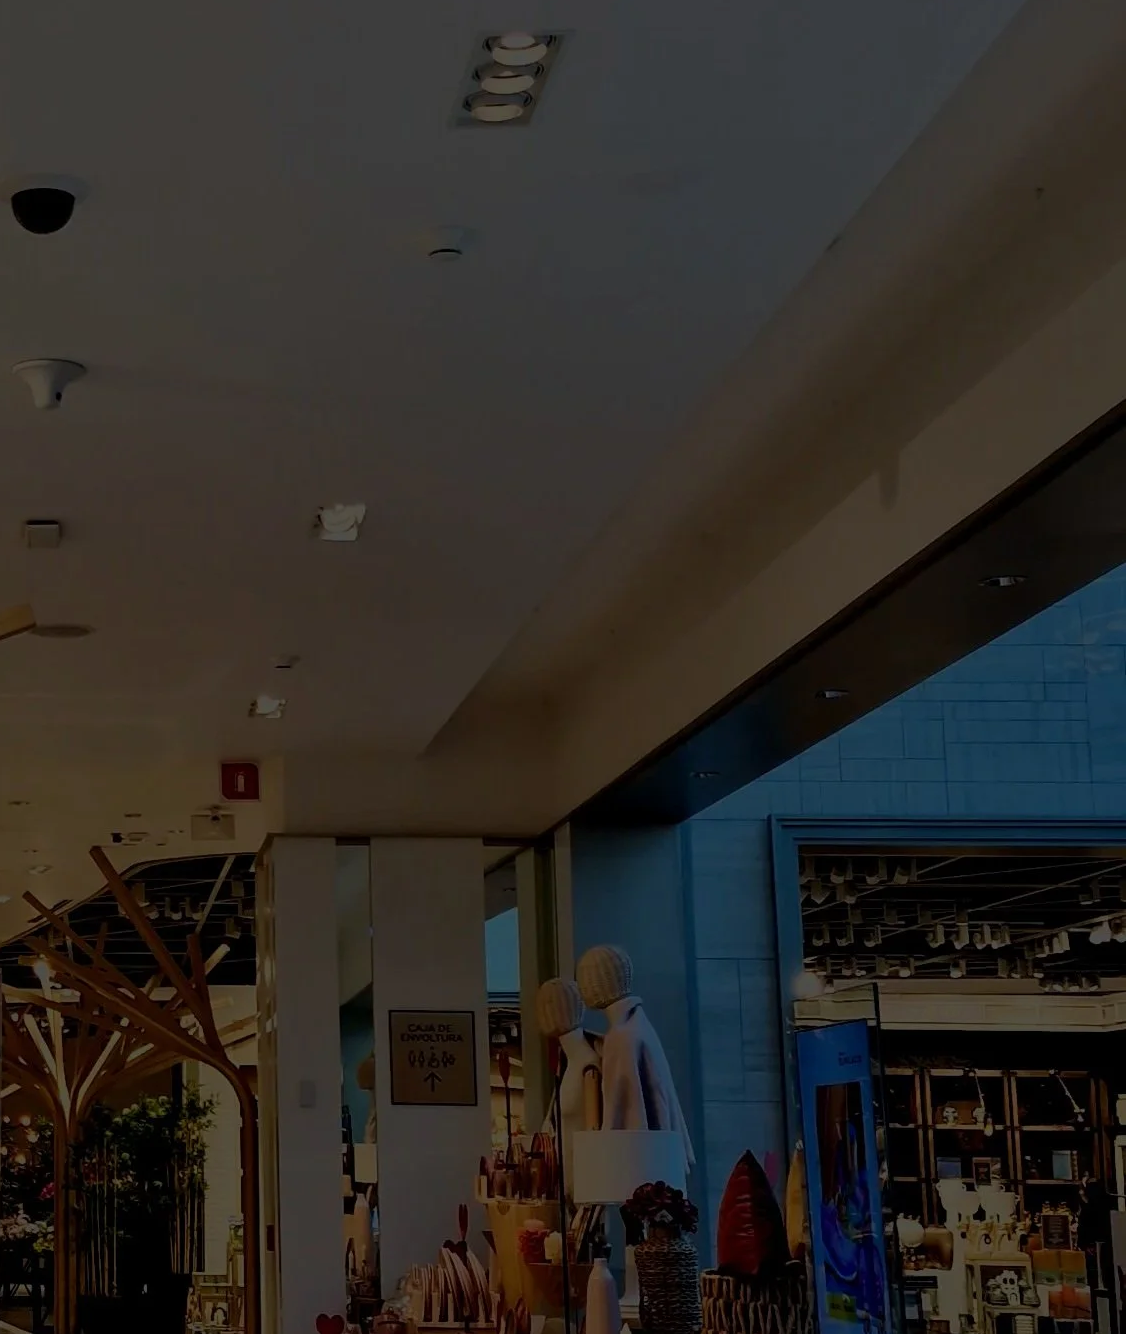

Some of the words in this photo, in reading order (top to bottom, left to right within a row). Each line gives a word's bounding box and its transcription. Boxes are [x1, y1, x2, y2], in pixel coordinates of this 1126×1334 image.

[408, 1024, 435, 1032] CAJA
[438, 1024, 452, 1033] DE
[401, 1033, 463, 1042] ENVOLTURA
